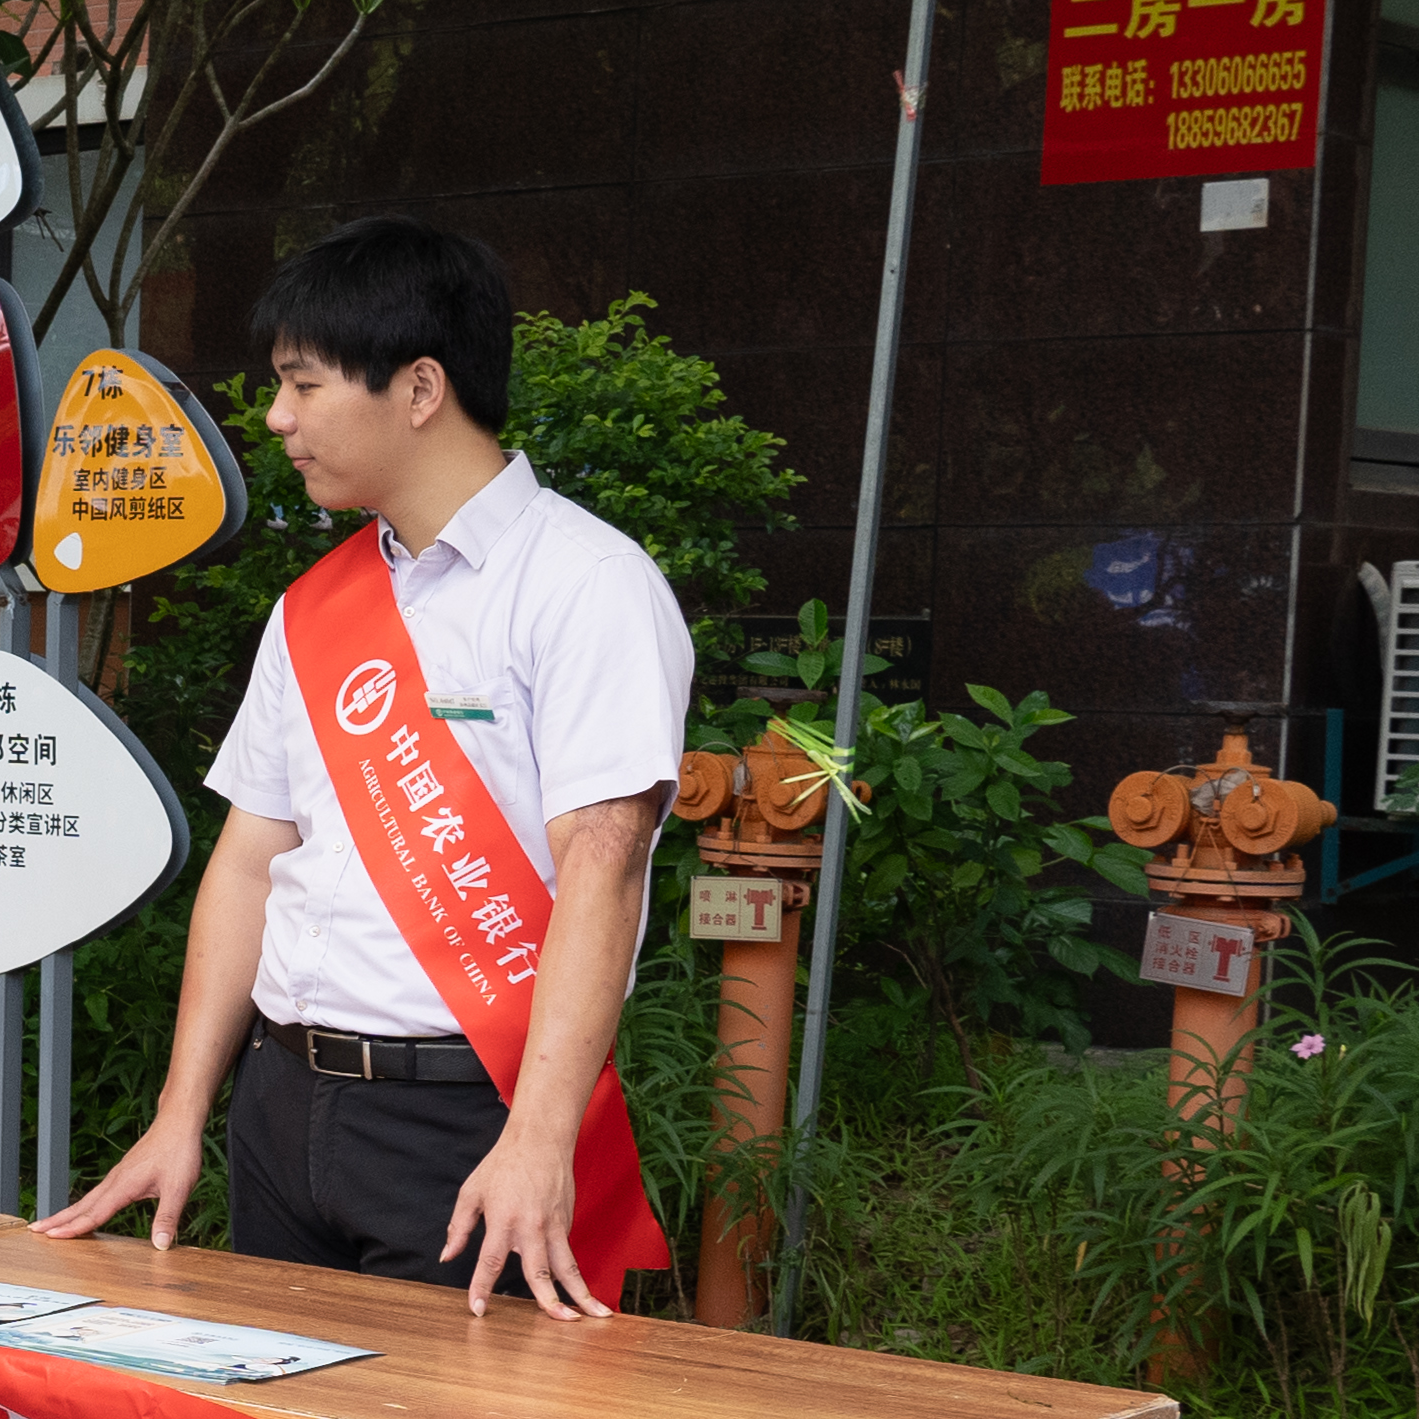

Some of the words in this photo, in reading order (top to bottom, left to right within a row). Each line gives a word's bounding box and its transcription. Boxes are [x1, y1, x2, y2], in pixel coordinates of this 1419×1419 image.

[1168, 50, 1307, 100] 13306066655
[1166, 103, 1303, 151] 18859682367
[81, 365, 124, 401] 7栋
[52, 425, 185, 459] 乐邻健身室
[73, 467, 167, 492] 室内健身区
[72, 496, 185, 522] 中国风剪纸区
[385, 724, 541, 985] 中国农业银行
[358, 758, 416, 873] AGRICULTURAL
[411, 873, 449, 925] BANK
[442, 924, 466, 951] OF
[459, 950, 498, 1007] CHINA
[698, 912, 737, 926] 接合器
[1152, 957, 1196, 976] 接合器
[1155, 941, 1199, 960] 消火栓
